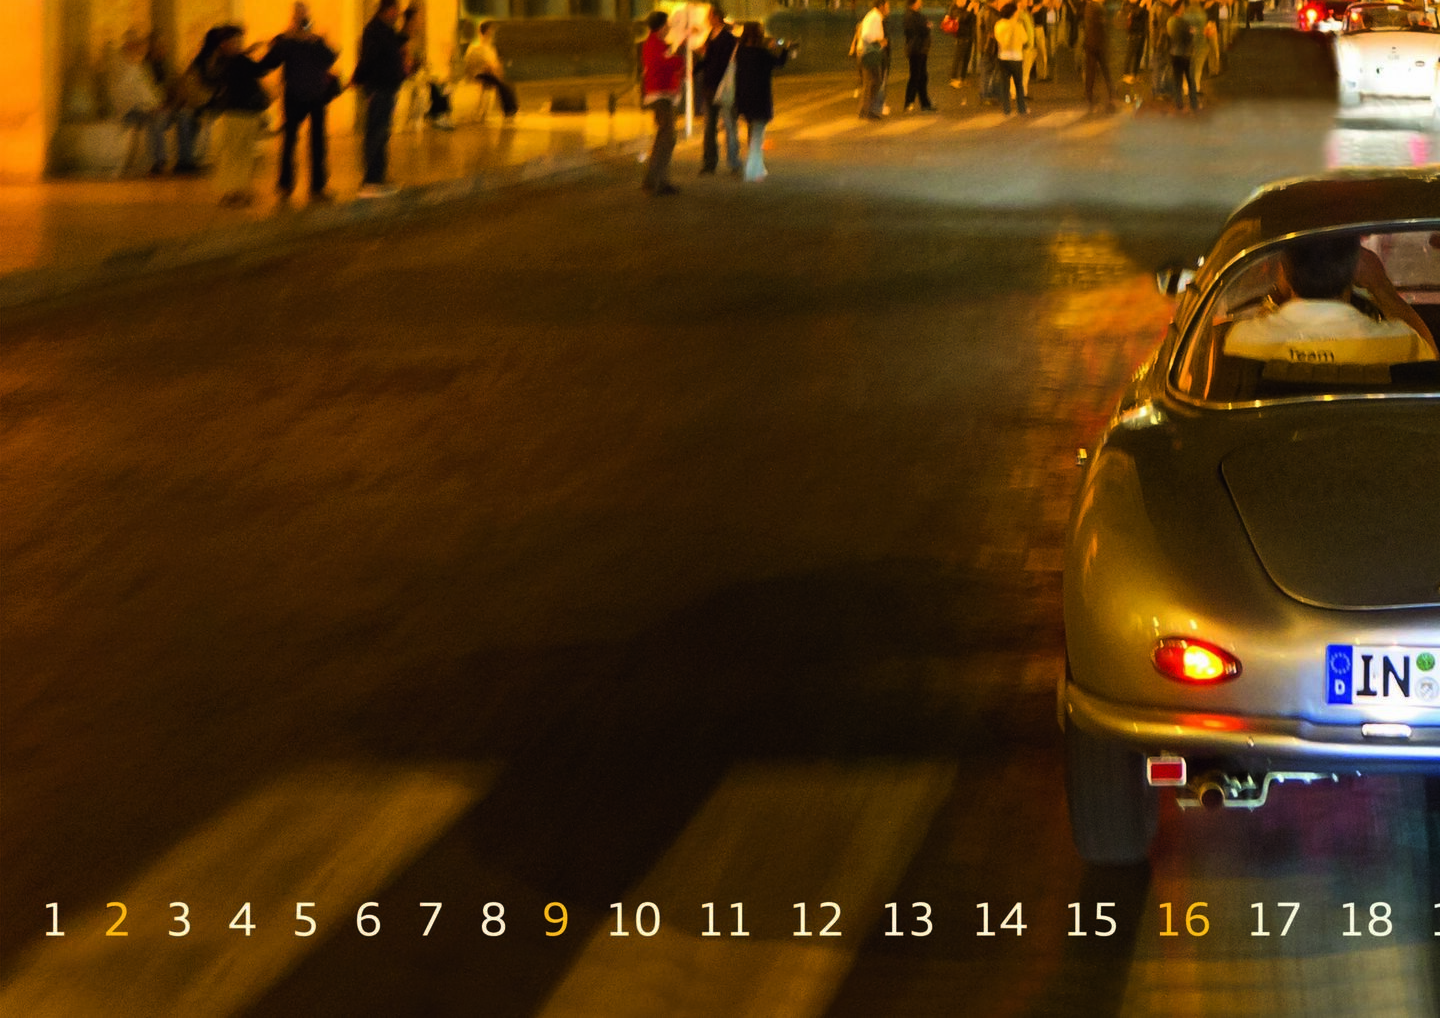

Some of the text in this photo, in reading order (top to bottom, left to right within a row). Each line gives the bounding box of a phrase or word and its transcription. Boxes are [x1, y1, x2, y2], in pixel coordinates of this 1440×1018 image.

[1288, 348, 1335, 363] Team
[1356, 654, 1410, 698] IN
[1334, 679, 1346, 696] D
